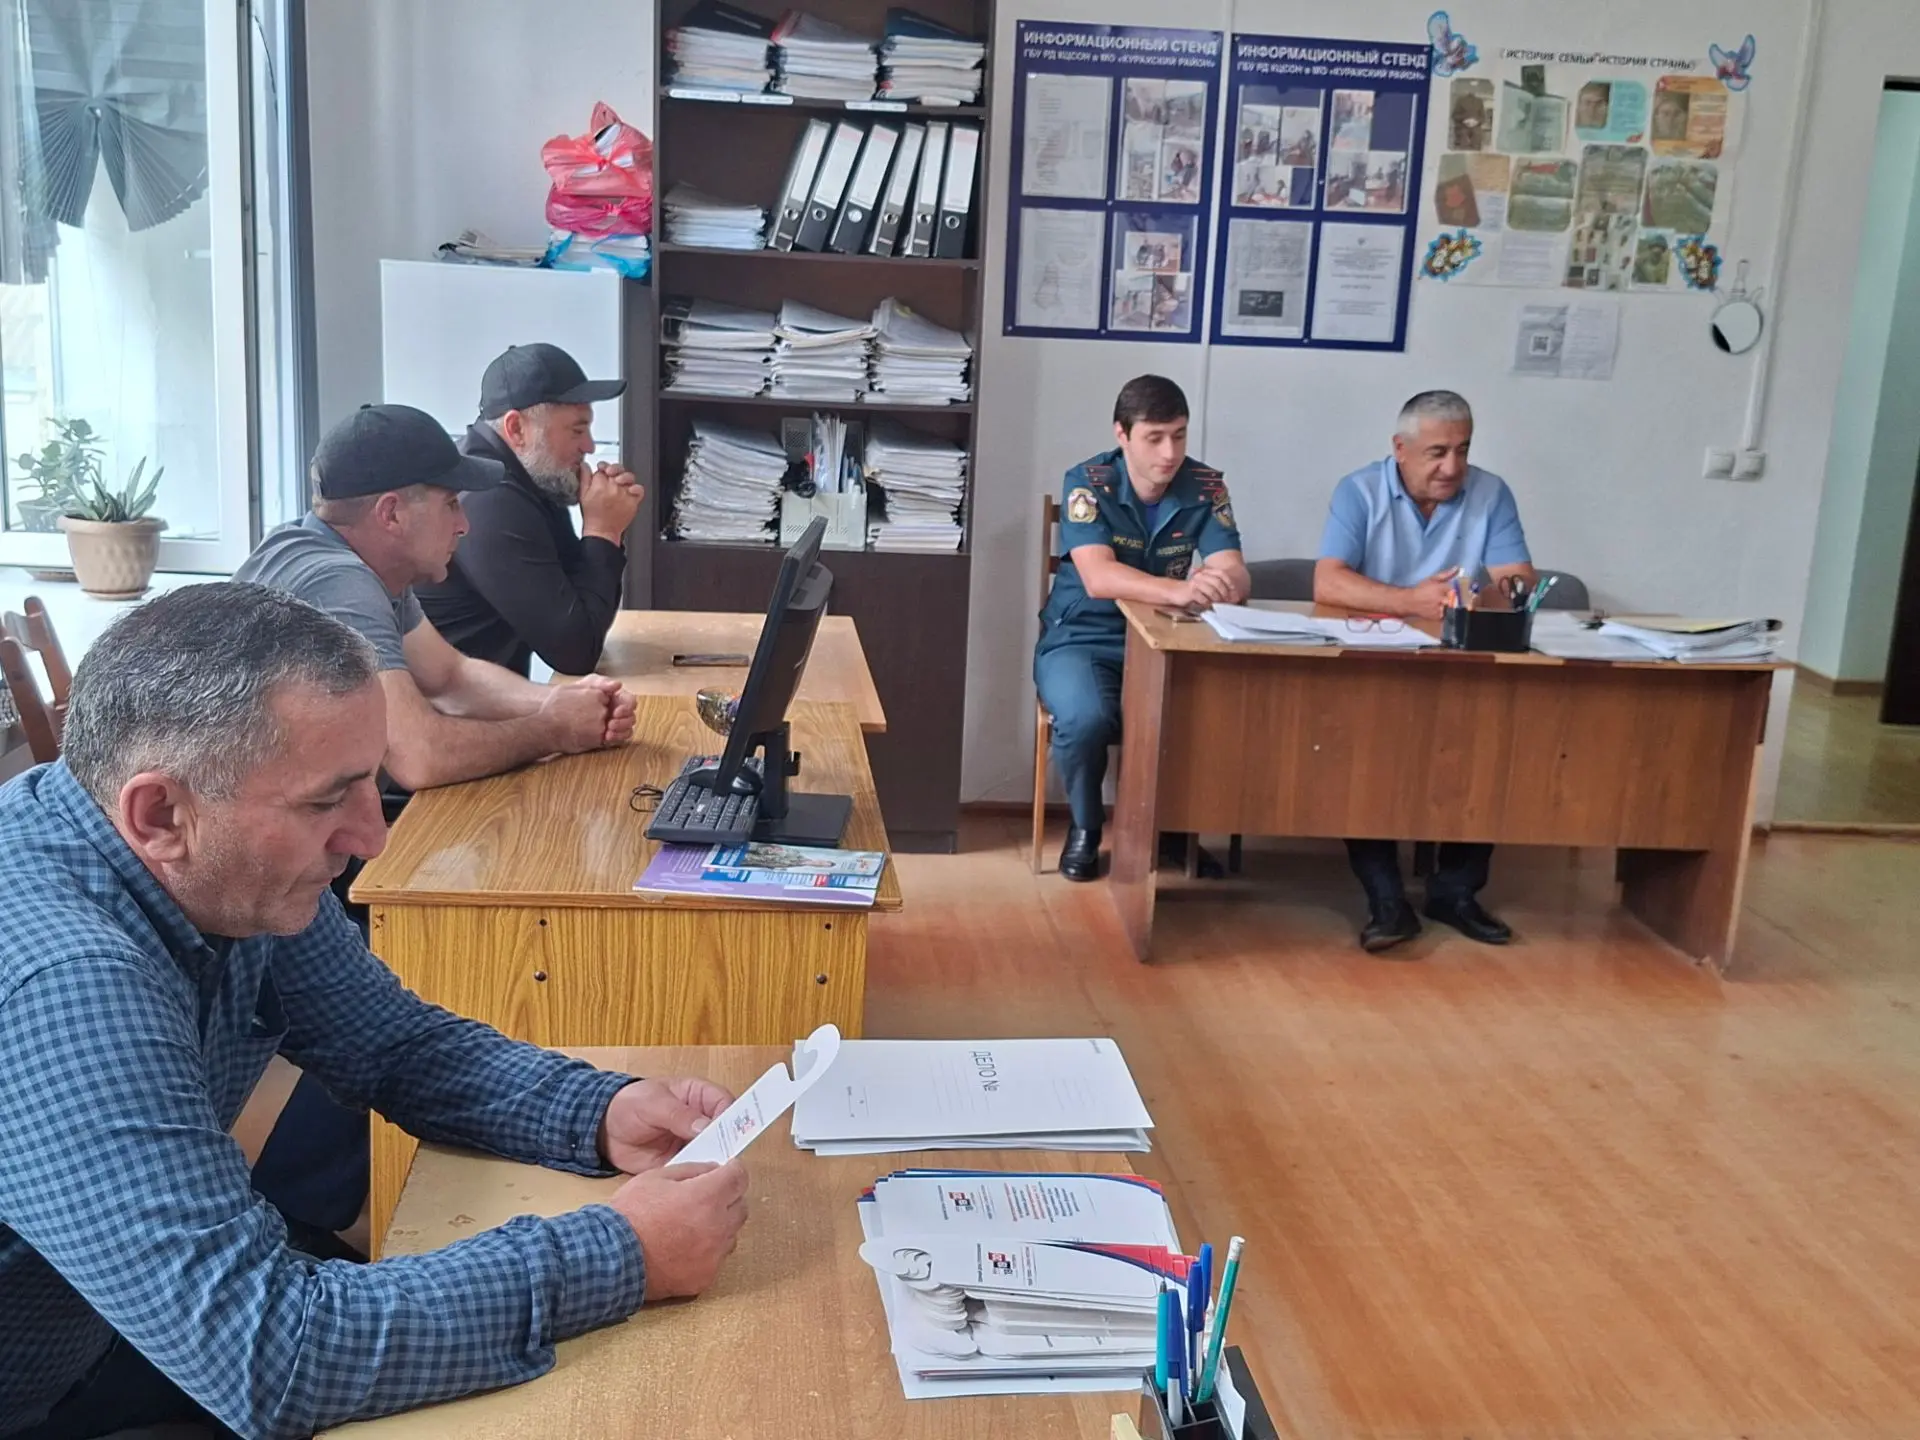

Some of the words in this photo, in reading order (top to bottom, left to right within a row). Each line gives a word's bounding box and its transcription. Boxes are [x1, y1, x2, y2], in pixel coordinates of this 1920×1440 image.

[1023, 32, 1168, 51] ИНФОРМАЦИОННЫЙ
[1170, 40, 1217, 55] СТЕНД
[1238, 44, 1379, 64] ИНФОРМАЦИОННЫЙ
[1381, 53, 1427, 69] СТЕНД
[970, 1051, 997, 1077] ДЕЛО
[980, 1080, 1000, 1091] №
